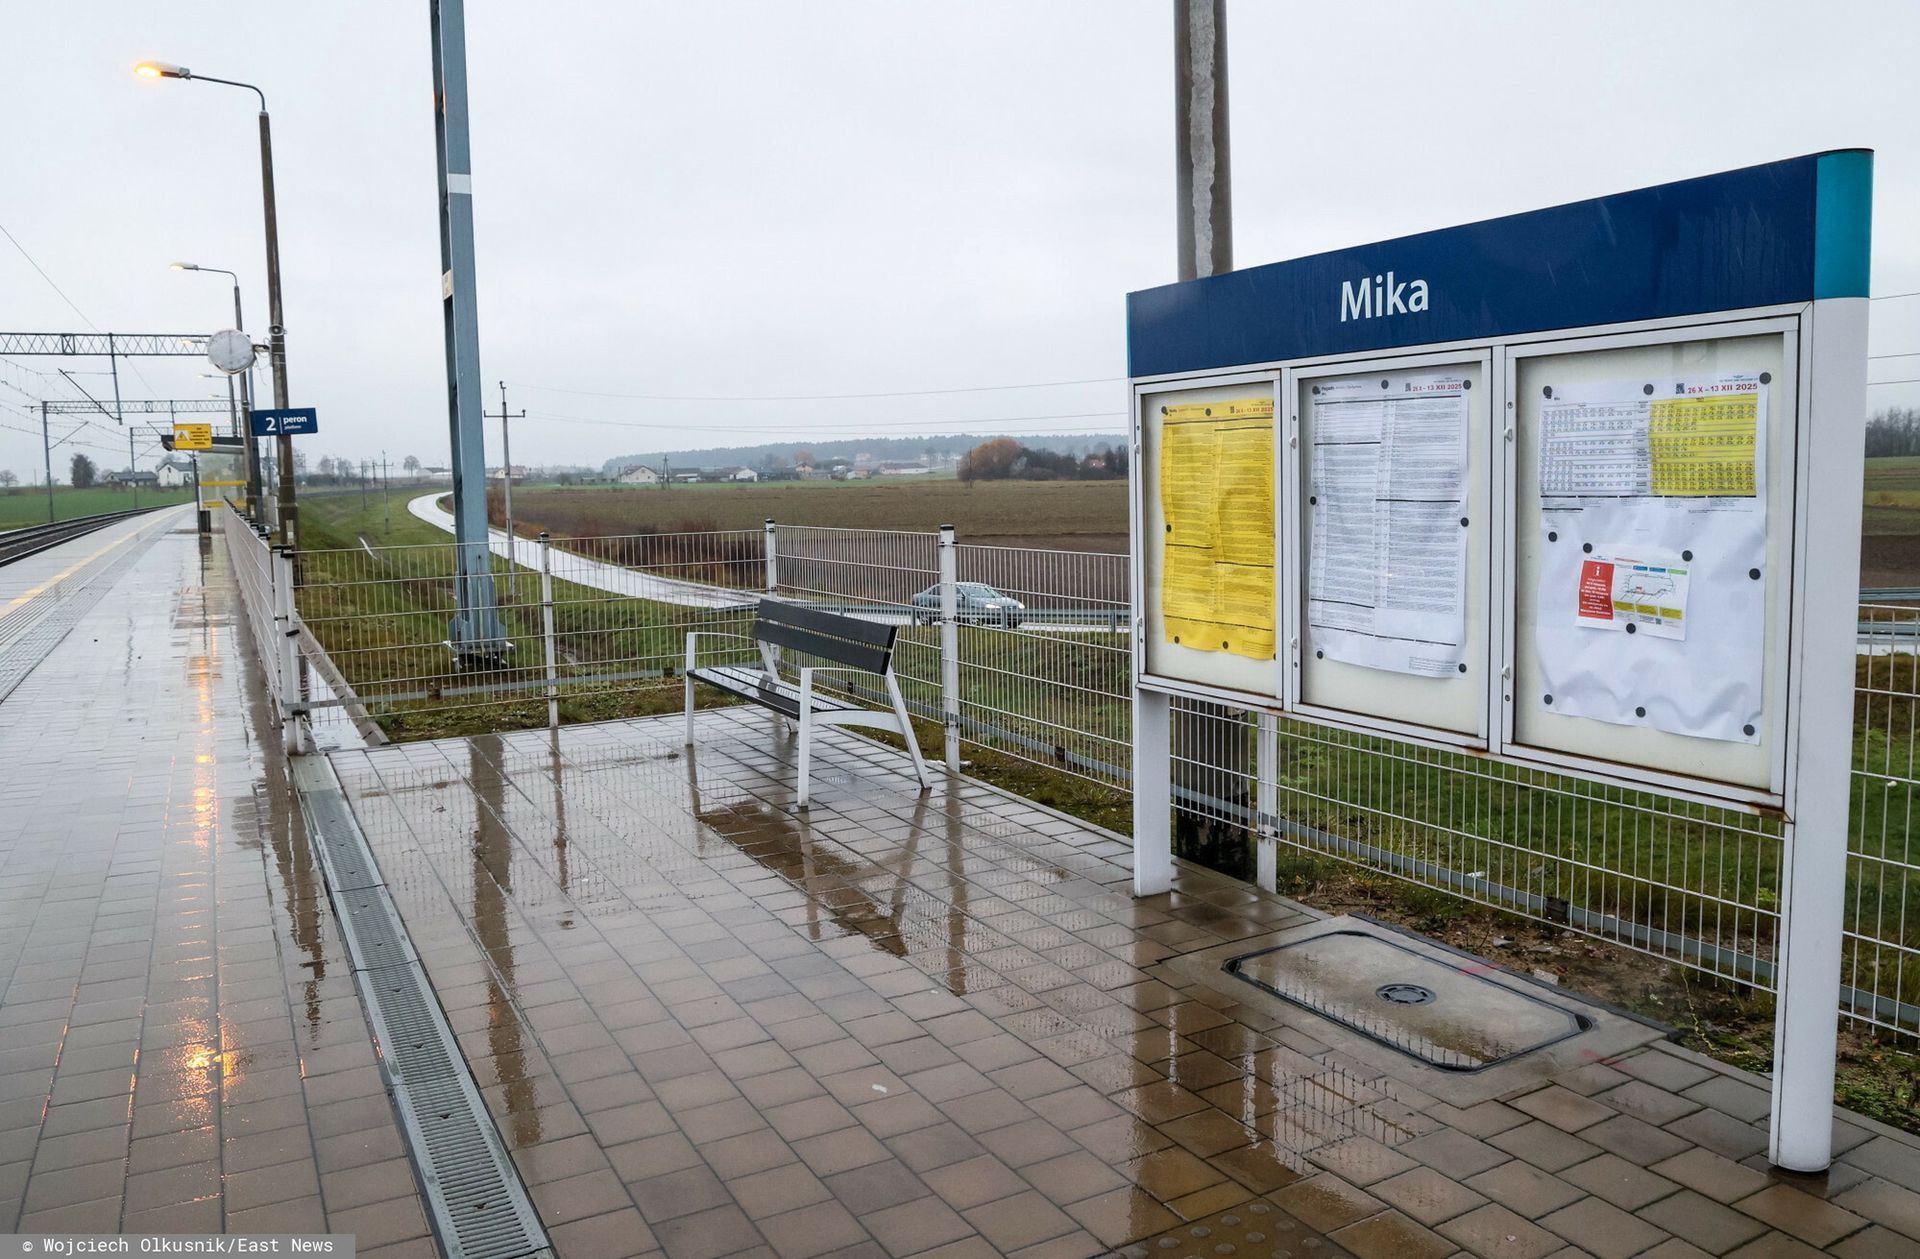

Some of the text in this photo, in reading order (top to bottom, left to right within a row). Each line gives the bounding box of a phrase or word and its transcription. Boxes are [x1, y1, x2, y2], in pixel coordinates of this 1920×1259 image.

[1340, 271, 1429, 322] Mika
[265, 416, 307, 432] 2 peron
